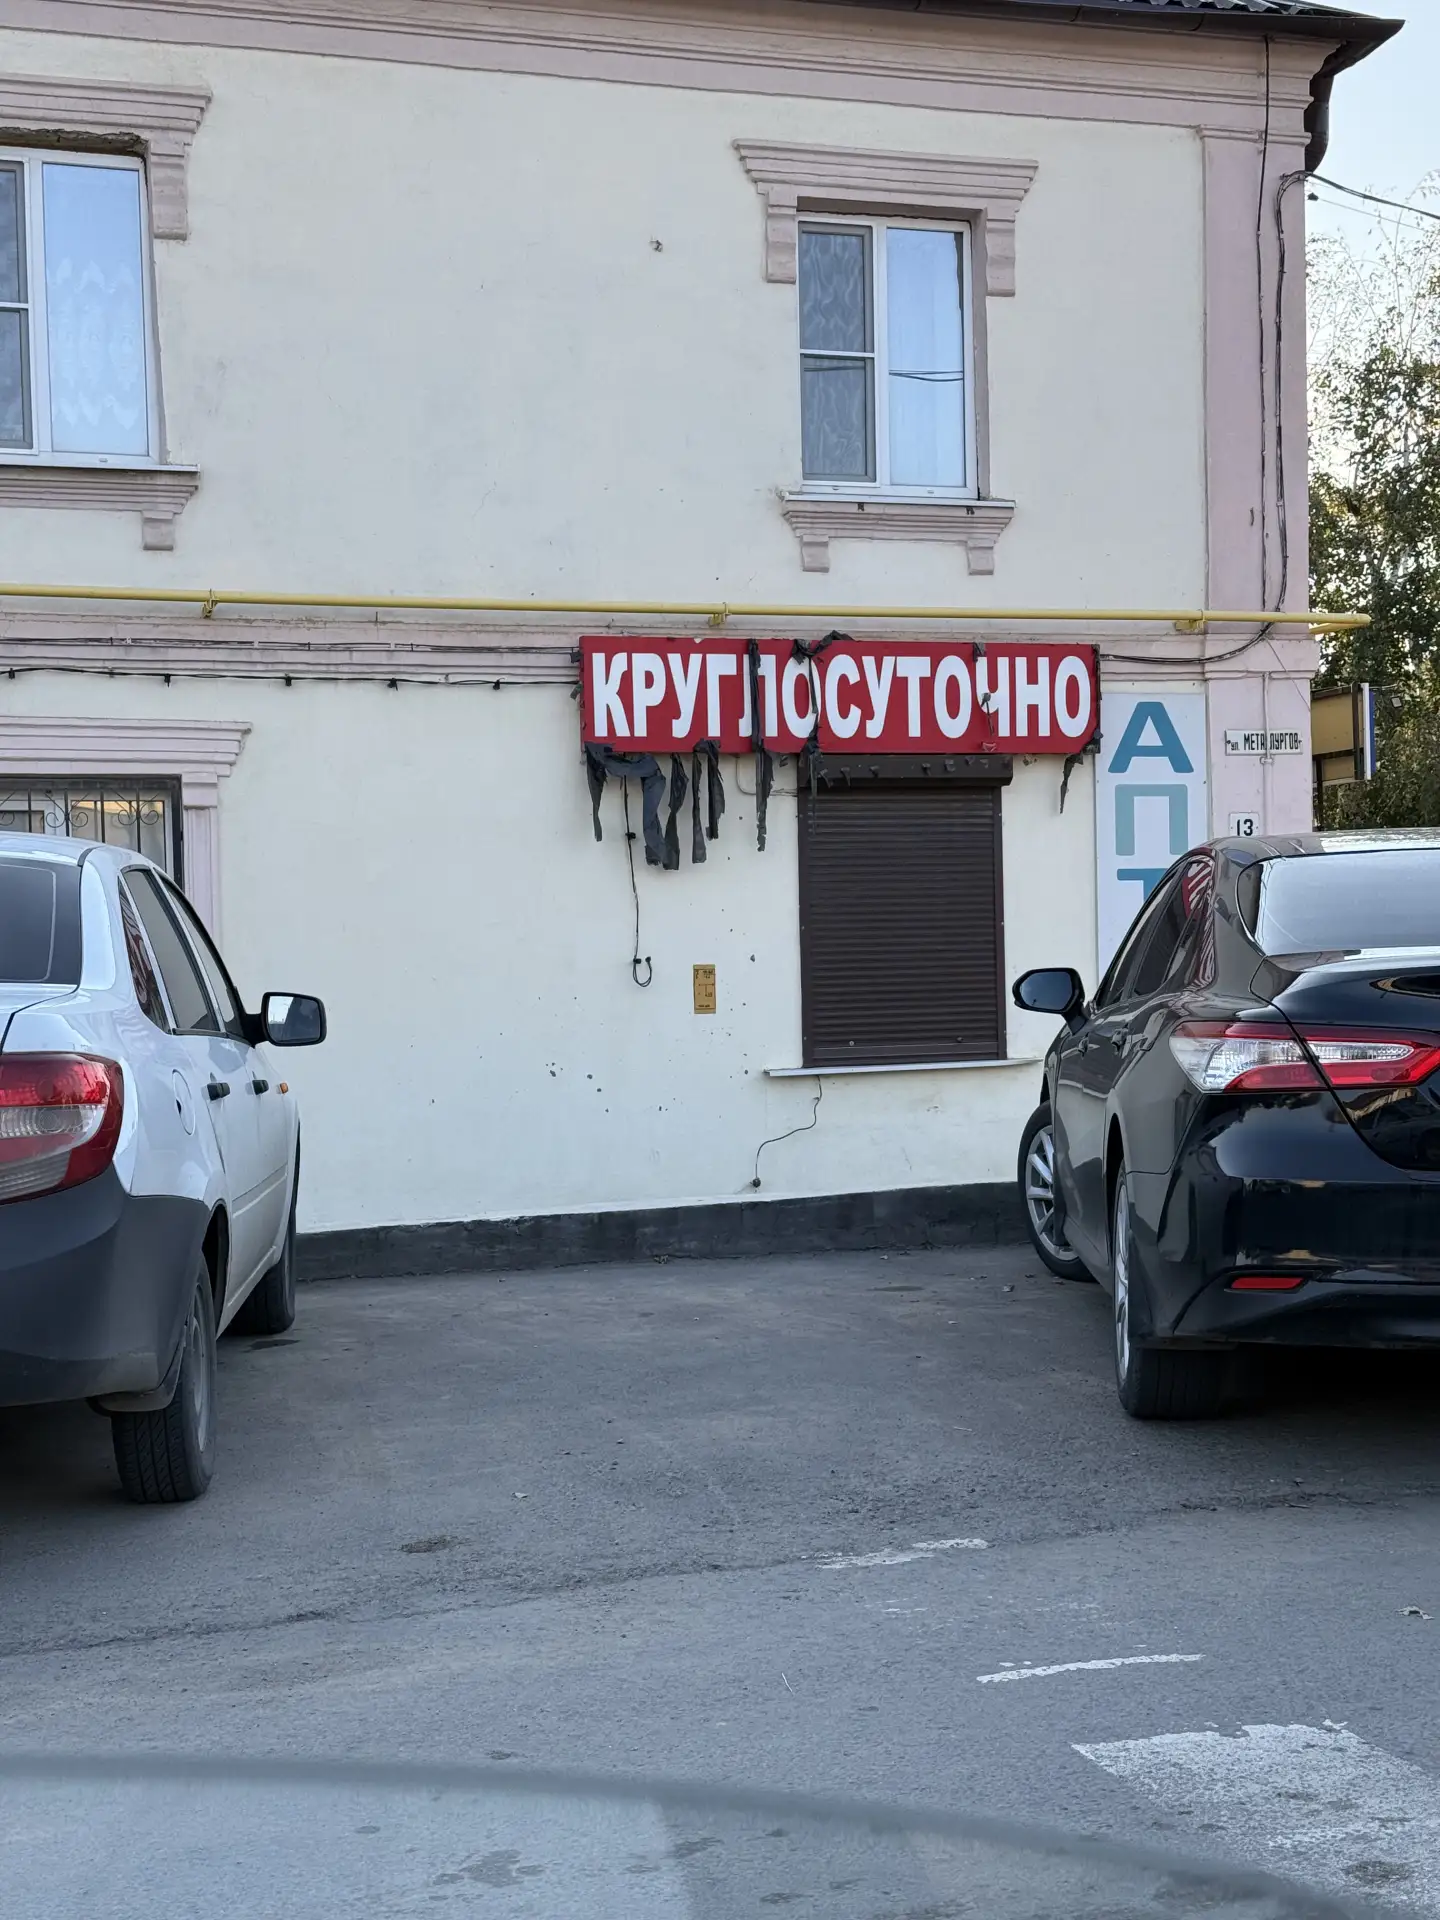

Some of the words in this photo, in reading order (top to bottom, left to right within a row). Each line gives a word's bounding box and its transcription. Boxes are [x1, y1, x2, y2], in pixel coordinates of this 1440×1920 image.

[591, 652, 1091, 739] КРУГЛОСУТОЧНО
[1243, 732, 1299, 751] МЕТАЛУРГОВ
[1236, 818, 1254, 837] 13
